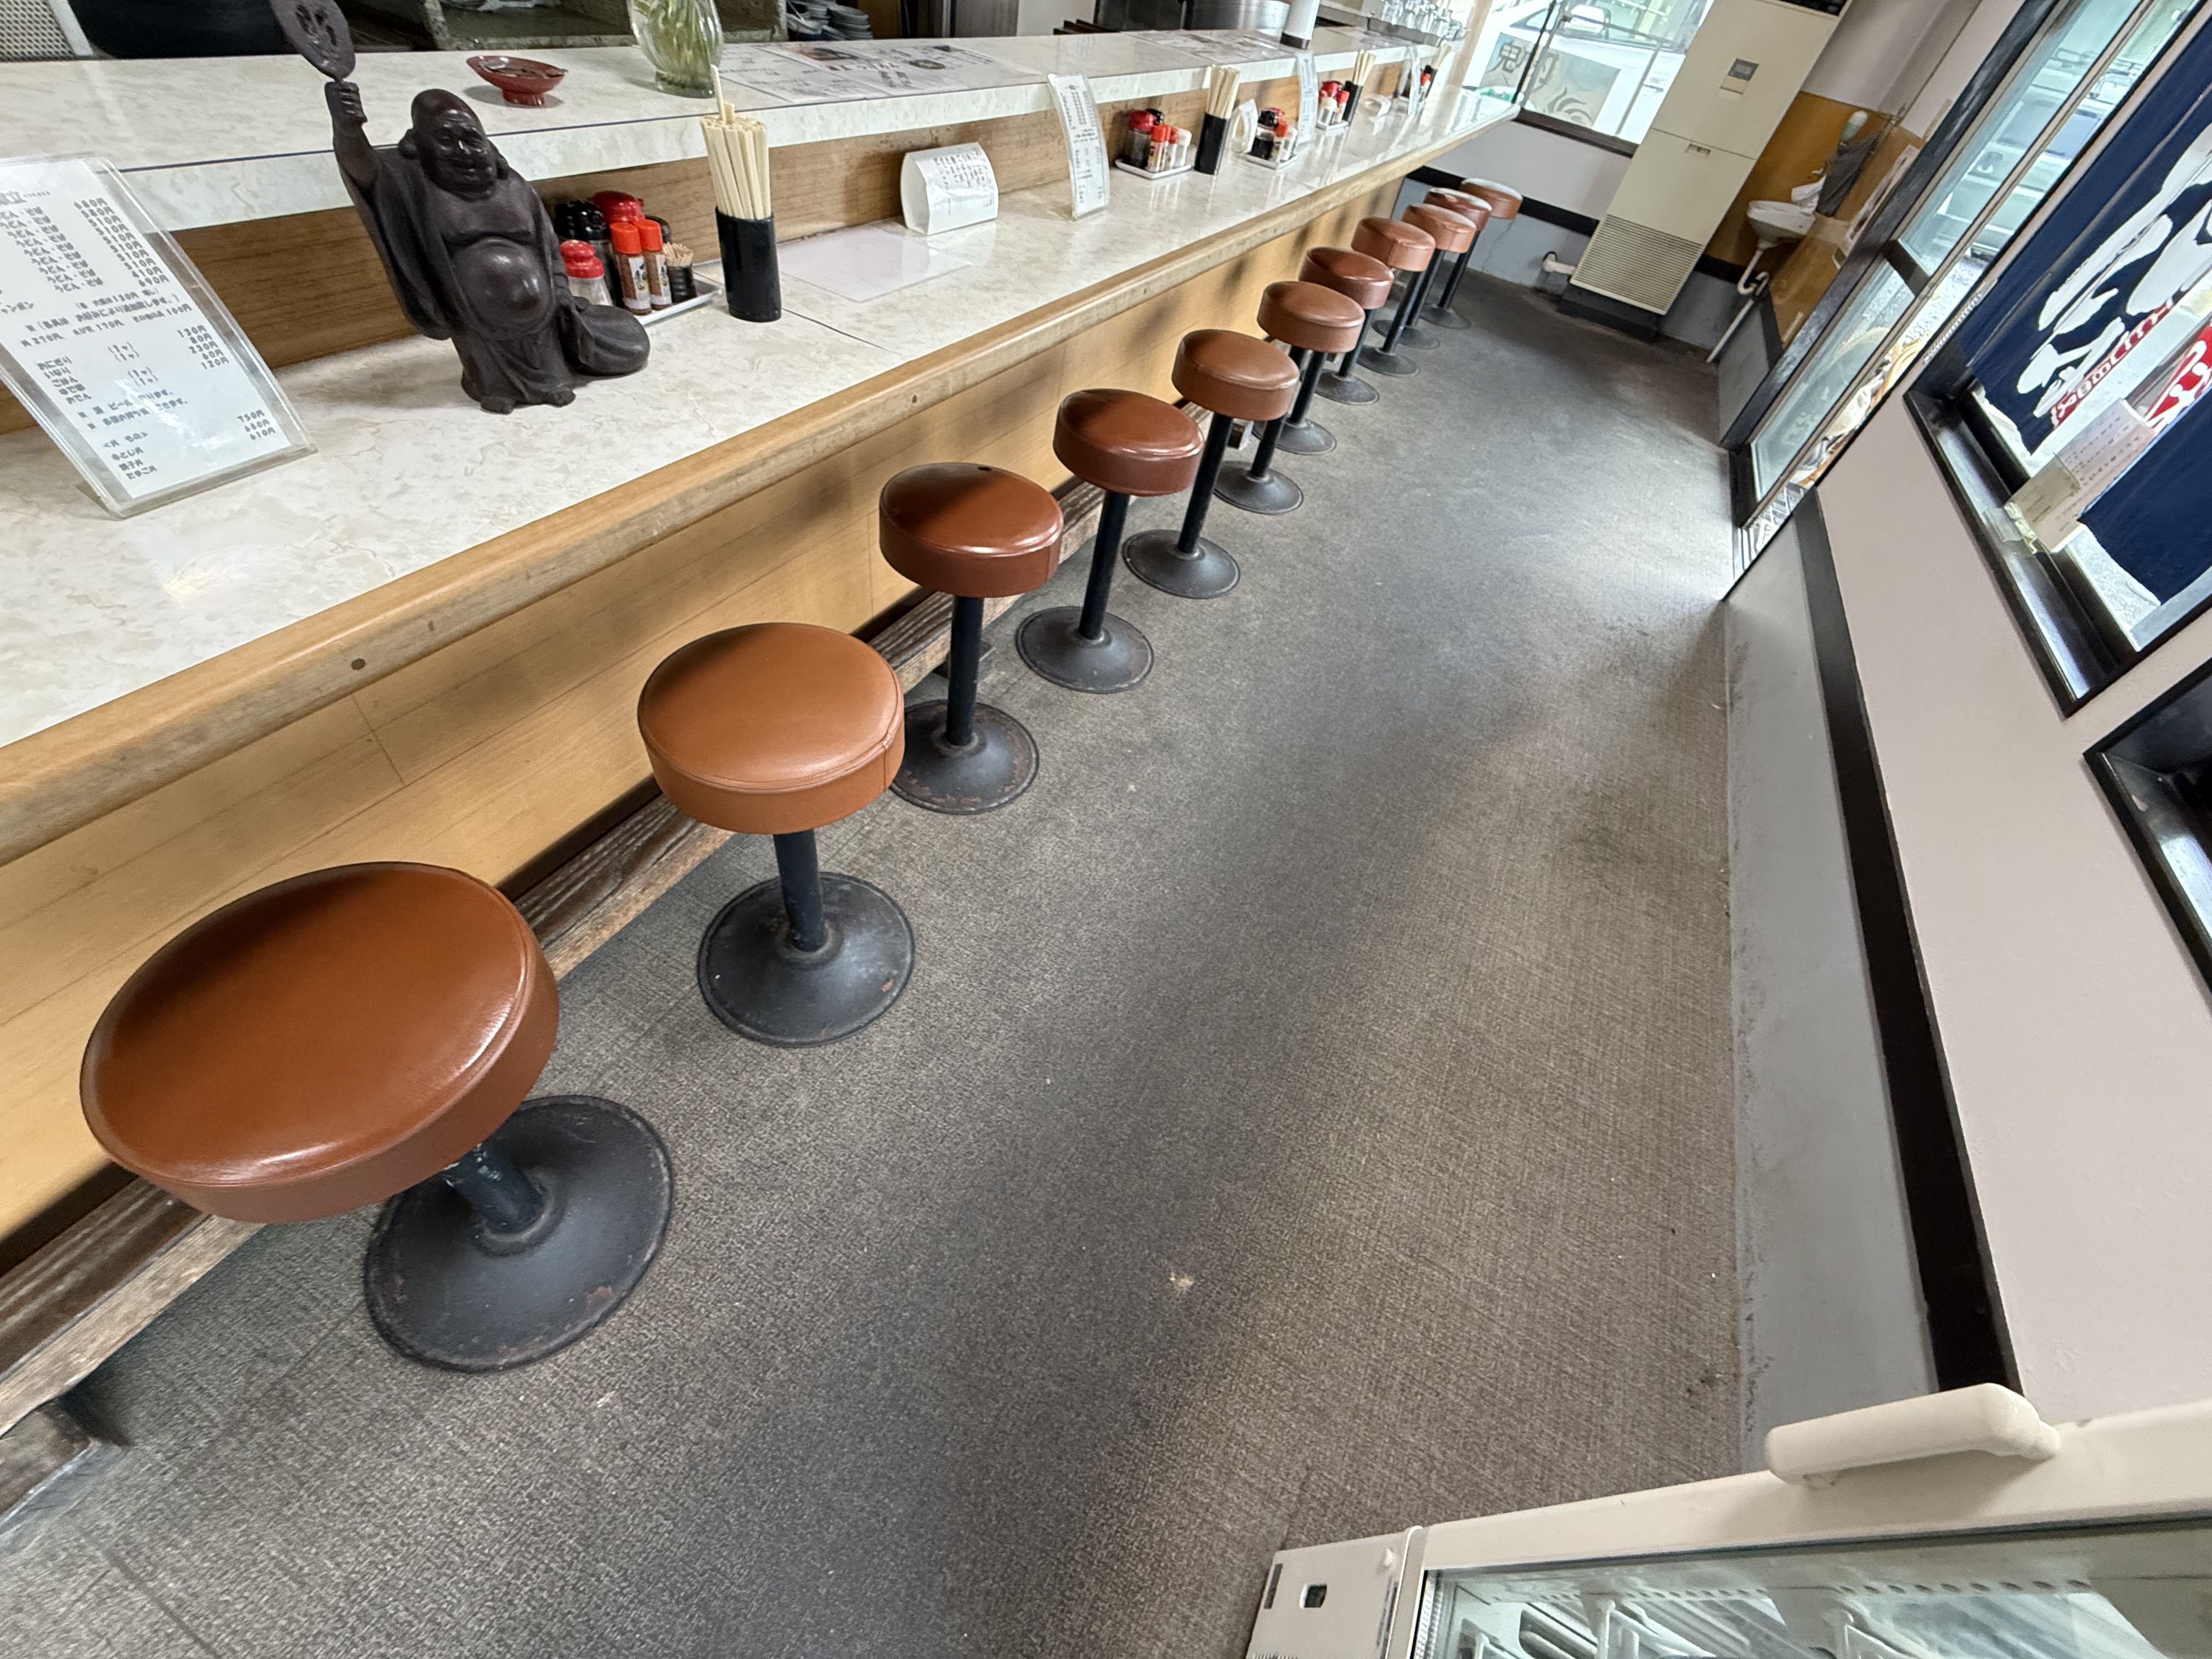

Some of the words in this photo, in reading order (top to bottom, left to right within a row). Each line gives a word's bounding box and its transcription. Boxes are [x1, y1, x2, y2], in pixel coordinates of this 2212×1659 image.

[88, 215, 122, 227] 510円
[95, 224, 129, 236] 510円
[103, 233, 136, 244] 510円
[110, 241, 143, 253] 510円
[117, 250, 149, 261] 510円
[124, 258, 156, 270] 510円
[139, 275, 170, 287] 690円
[166, 303, 192, 315] 100円
[177, 325, 207, 338] 130円
[188, 341, 218, 354] 230円
[202, 349, 224, 360] 60円
[201, 357, 229, 369] 120円
[237, 409, 265, 422] 750円
[250, 427, 276, 440] 610円
